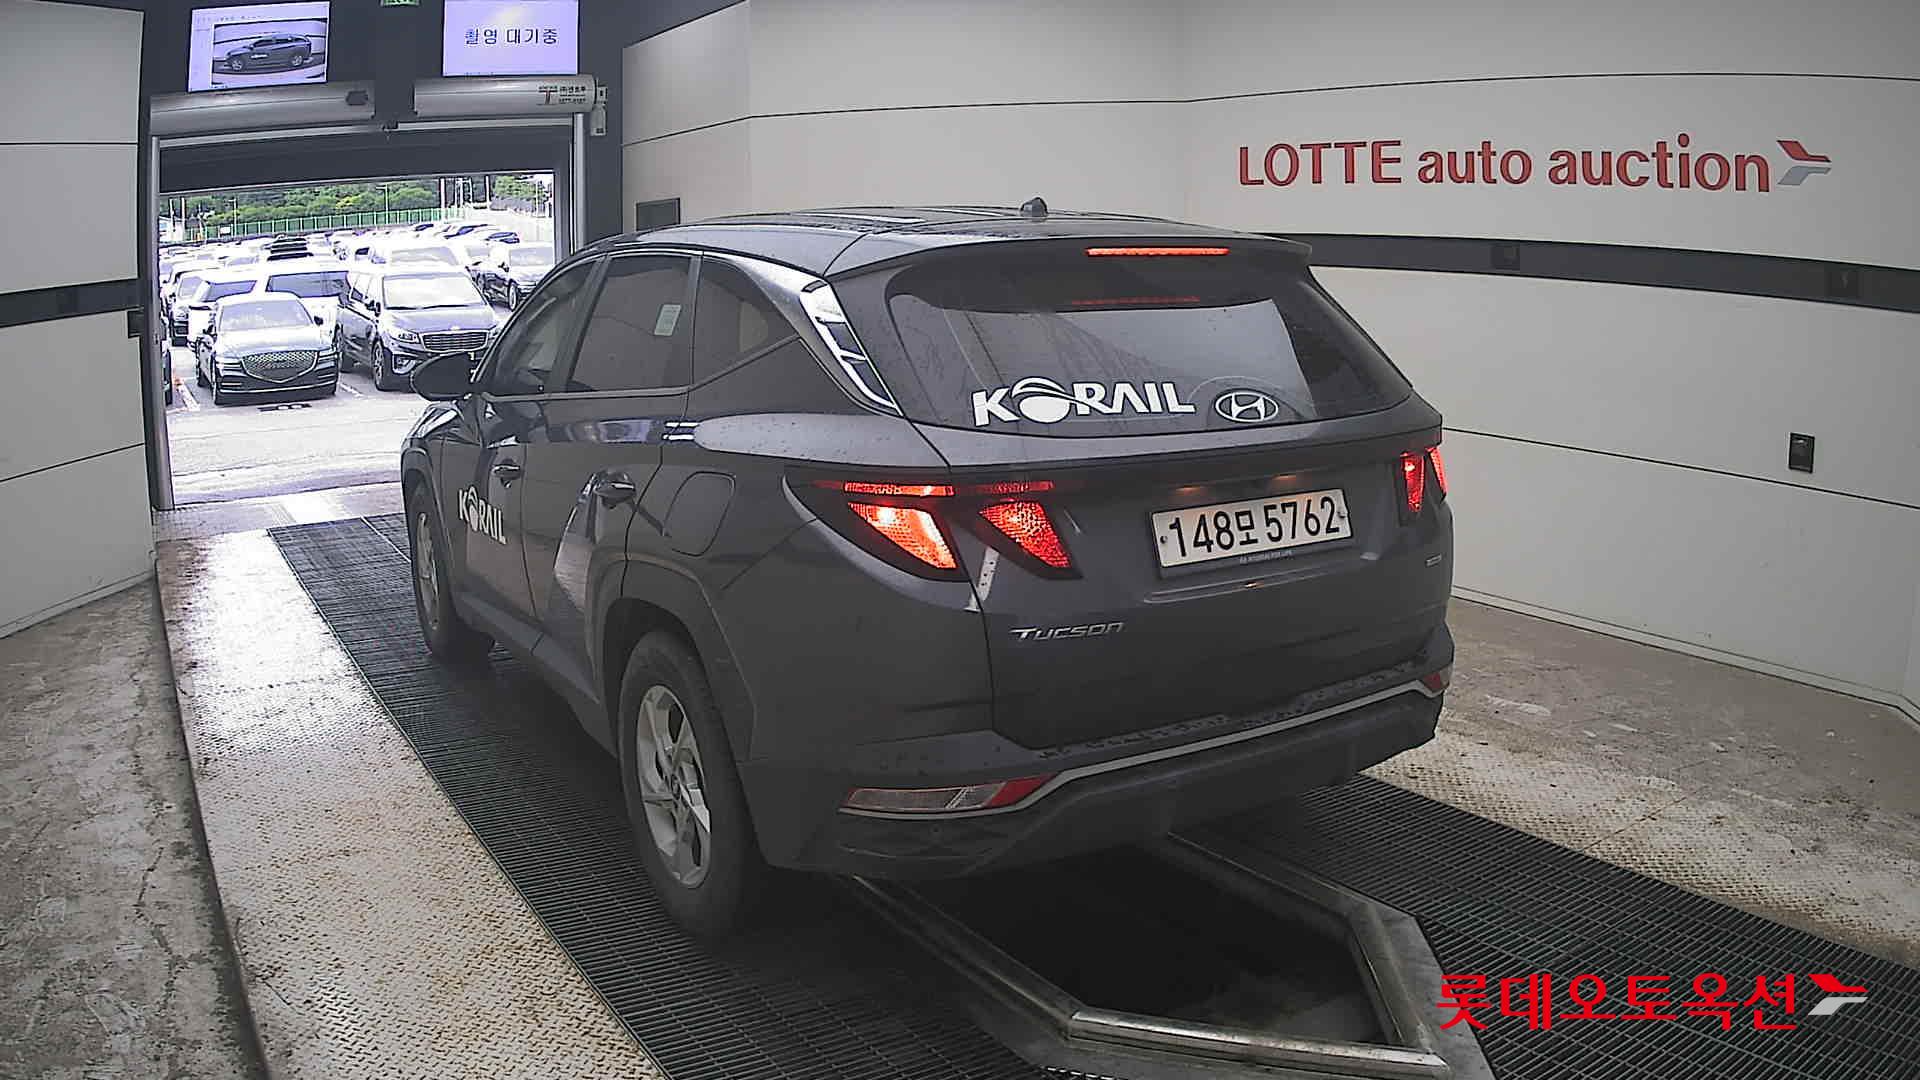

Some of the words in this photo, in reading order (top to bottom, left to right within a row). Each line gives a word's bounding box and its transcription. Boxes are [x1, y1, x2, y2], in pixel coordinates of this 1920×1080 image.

[506, 27, 558, 45] 대기중
[1239, 140, 1402, 186] LOTTE
[1417, 141, 1533, 185] auto
[1548, 133, 1771, 194] auction
[971, 376, 1195, 427] KORAIL
[458, 486, 507, 545] KORAIL
[1169, 509, 1256, 558] 148모
[1263, 496, 1340, 543] 5762
